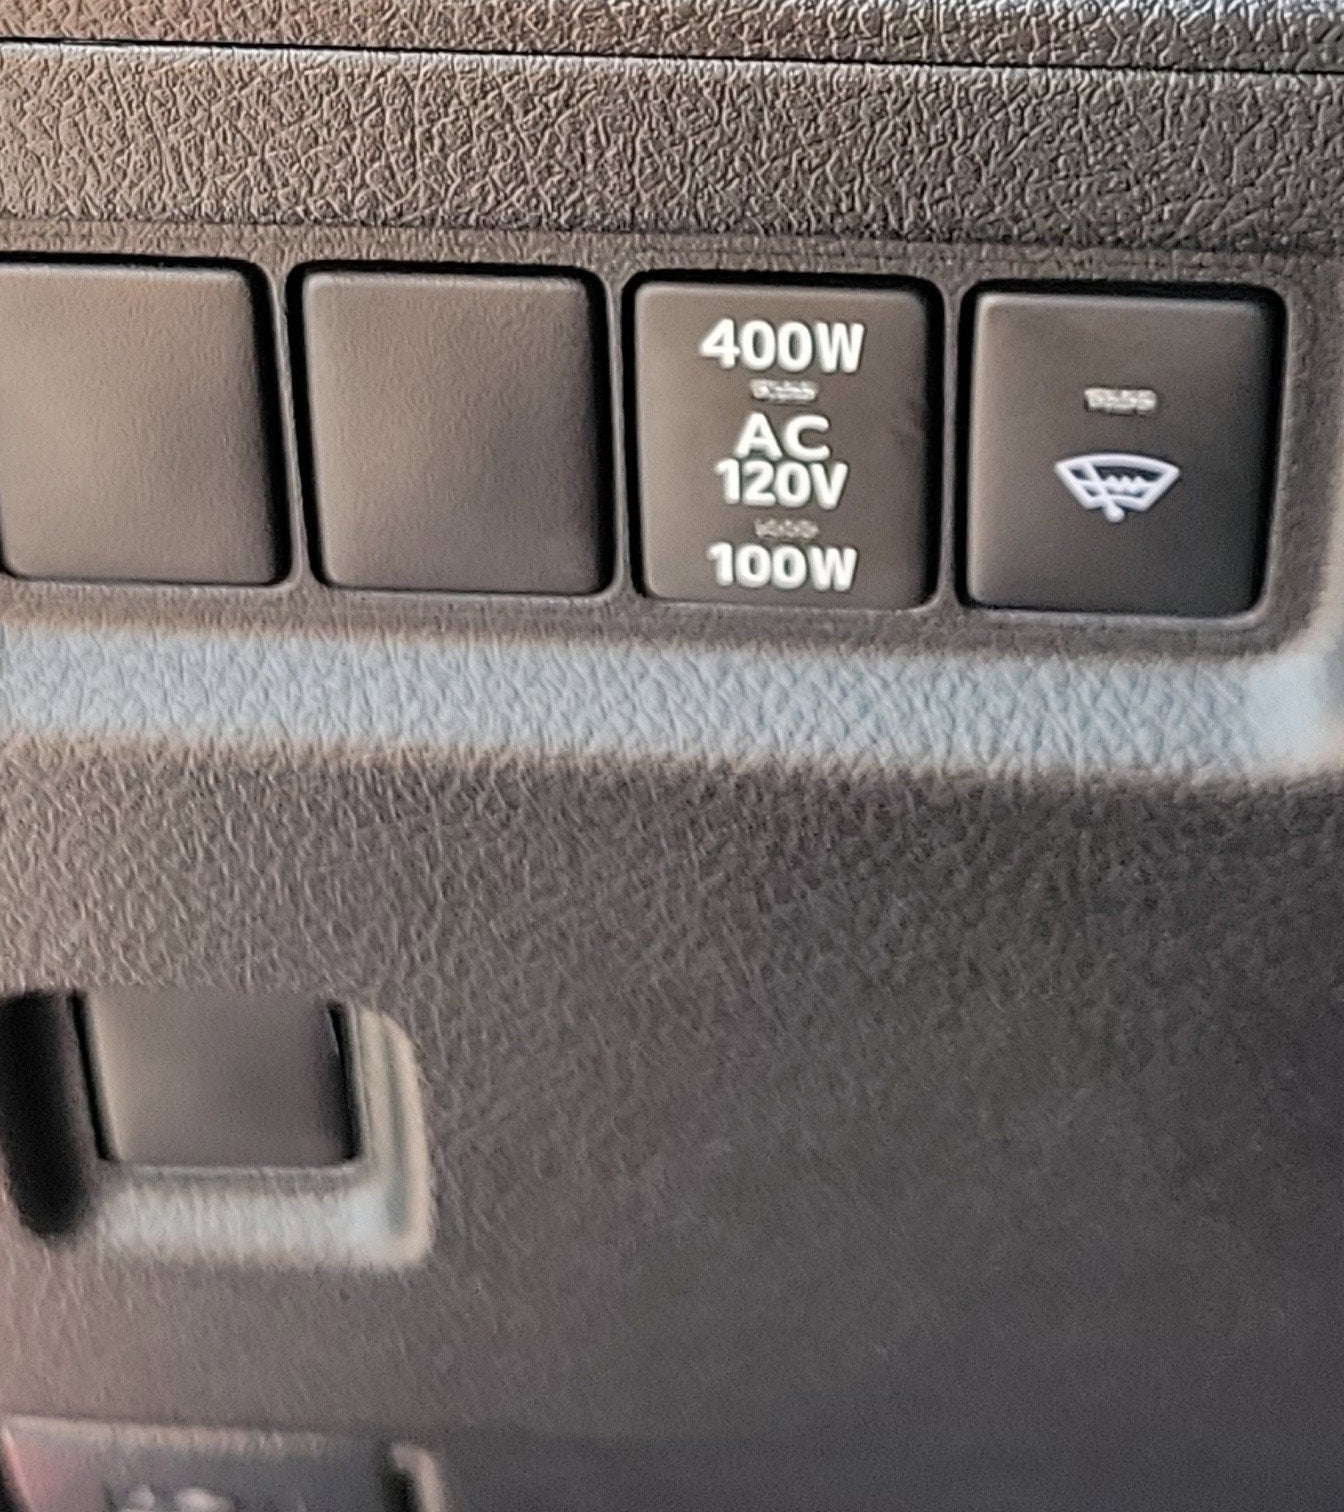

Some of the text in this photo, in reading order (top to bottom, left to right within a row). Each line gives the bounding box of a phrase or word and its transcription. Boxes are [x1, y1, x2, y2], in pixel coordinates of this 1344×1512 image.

[699, 318, 864, 373] 400W
[733, 411, 831, 461] AC
[714, 457, 848, 510] 120V
[708, 542, 857, 591] 100W
